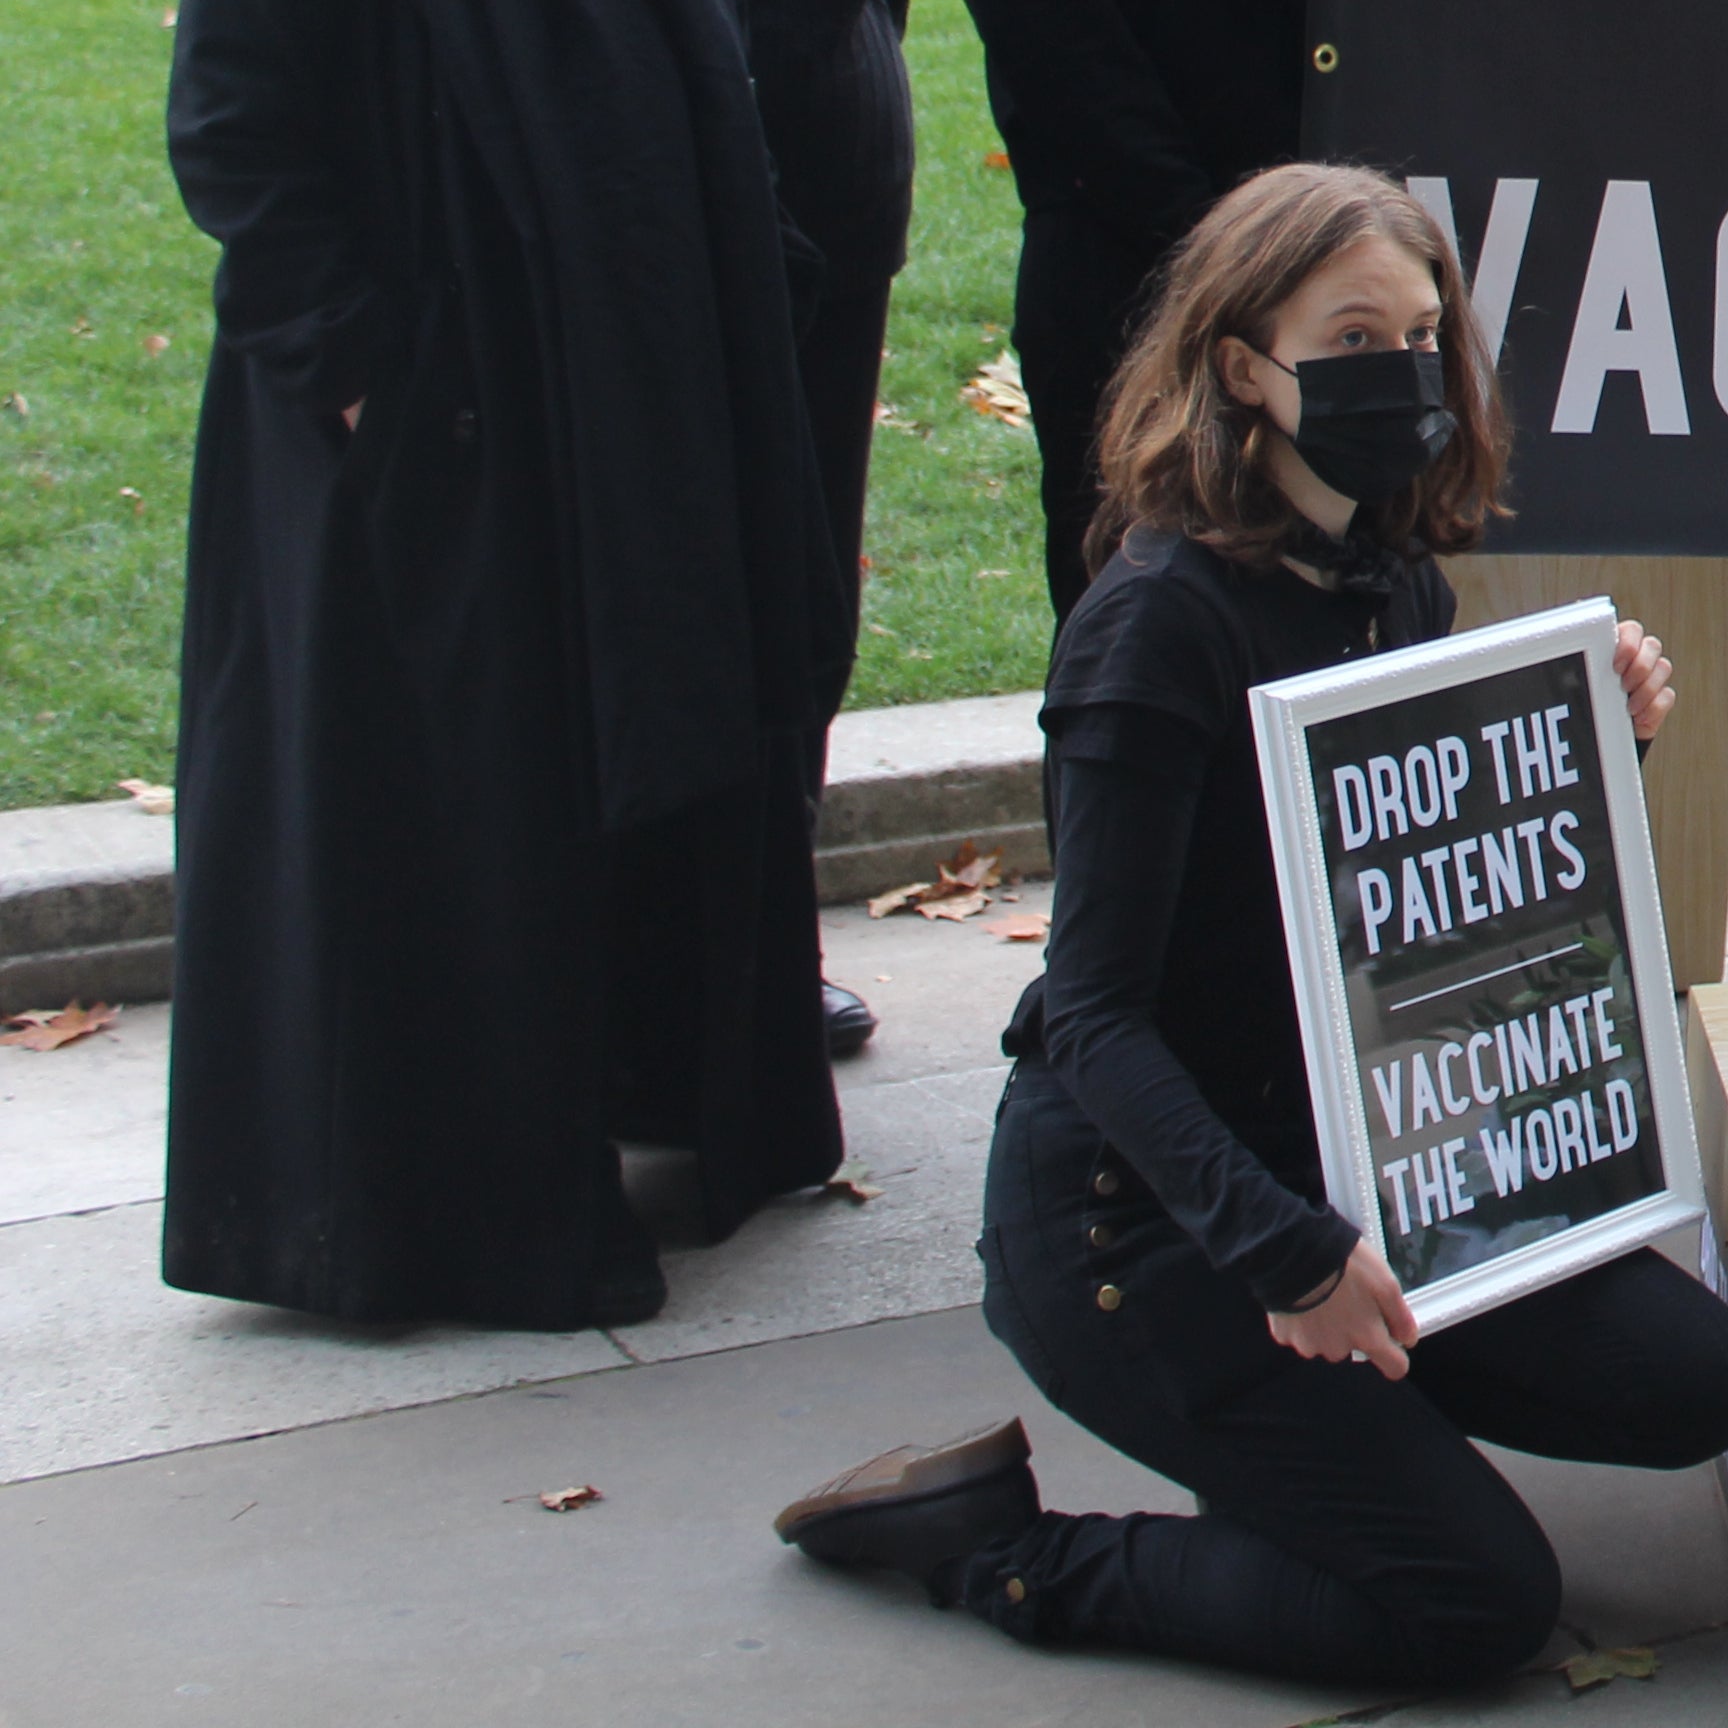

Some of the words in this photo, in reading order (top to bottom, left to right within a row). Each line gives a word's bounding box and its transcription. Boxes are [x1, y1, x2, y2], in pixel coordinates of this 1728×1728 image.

[1333, 735, 1469, 851] DROP
[1481, 704, 1579, 804] THE
[1357, 810, 1585, 955] PATENTS
[1371, 987, 1622, 1139] VACCINATE
[1382, 1136, 1474, 1235] THE
[1479, 1079, 1637, 1198] WORLD
